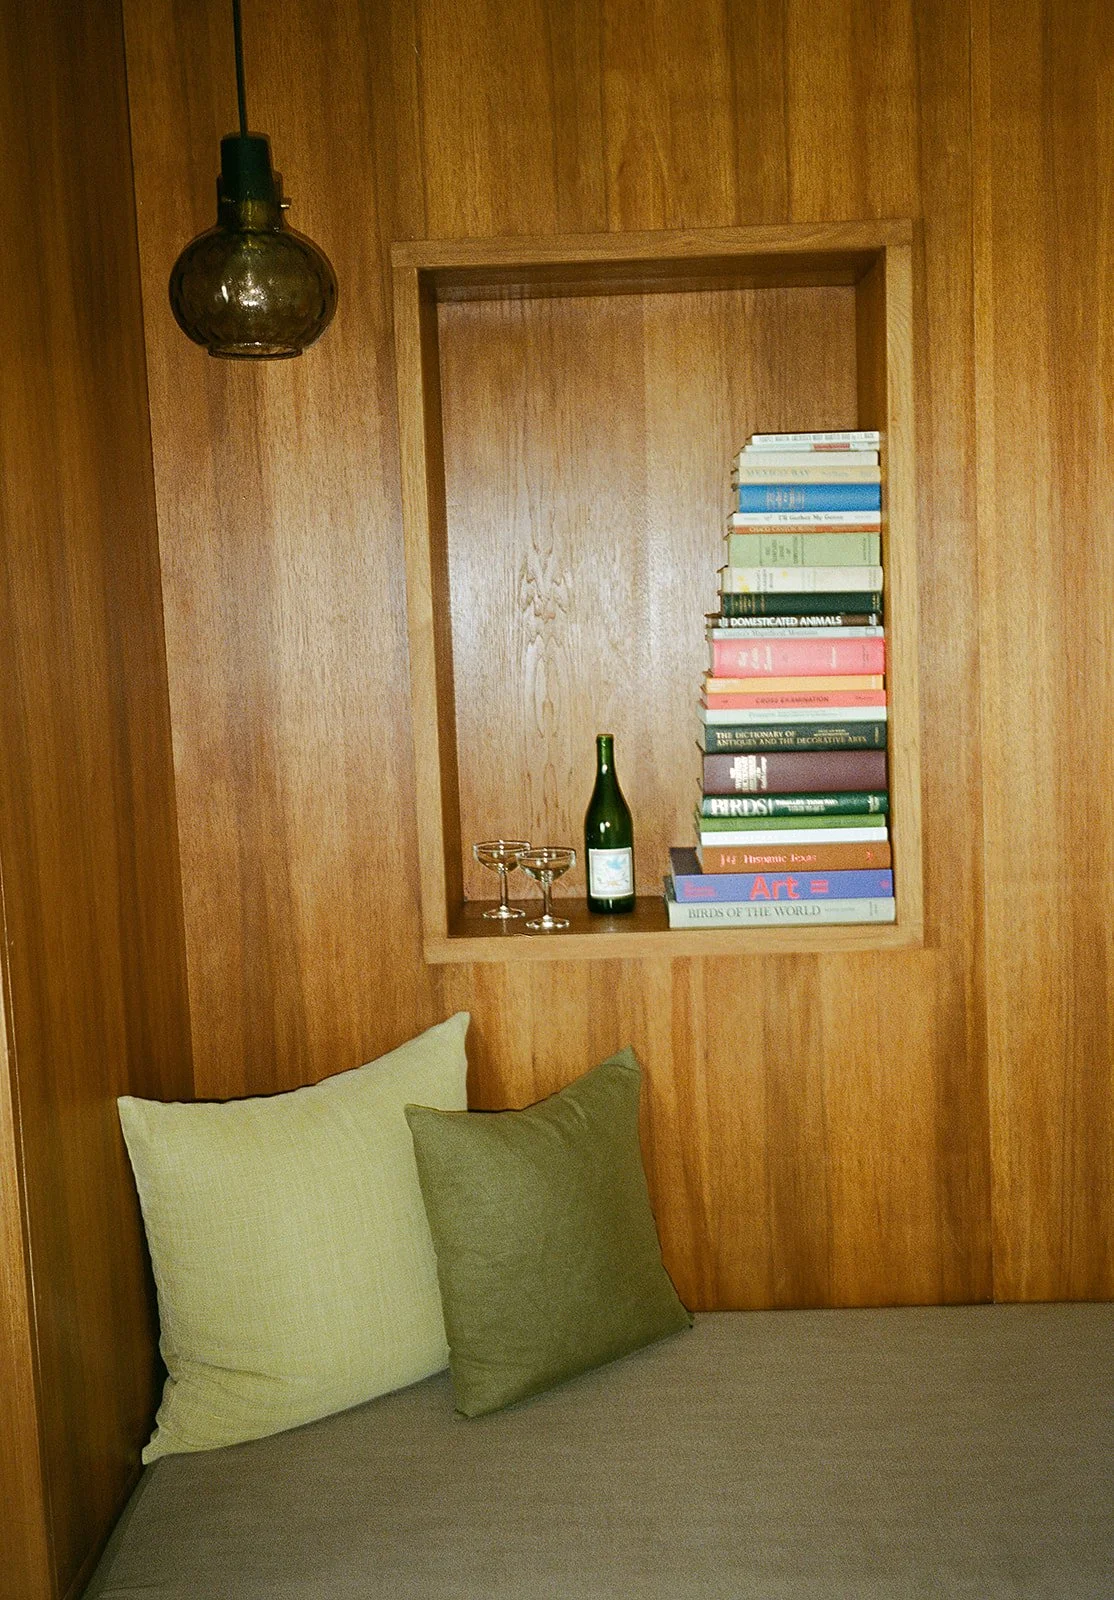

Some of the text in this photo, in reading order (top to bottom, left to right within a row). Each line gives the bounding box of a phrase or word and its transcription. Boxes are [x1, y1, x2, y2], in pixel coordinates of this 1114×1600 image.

[730, 615, 842, 627] DOMESTICATED ANIMALS
[716, 730, 796, 740] THE DICTIONARY OF
[717, 738, 757, 746] ANTIQUES
[779, 737, 795, 745] THE
[796, 736, 847, 744] DECORATIVE
[848, 735, 867, 743] ARTS
[743, 853, 787, 864] Hispanic
[790, 853, 817, 863] Texas
[750, 875, 800, 901] Art
[687, 907, 724, 919] BIRDS
[726, 906, 743, 918] OF
[744, 906, 771, 917] THE
[773, 905, 821, 917] WORLD
